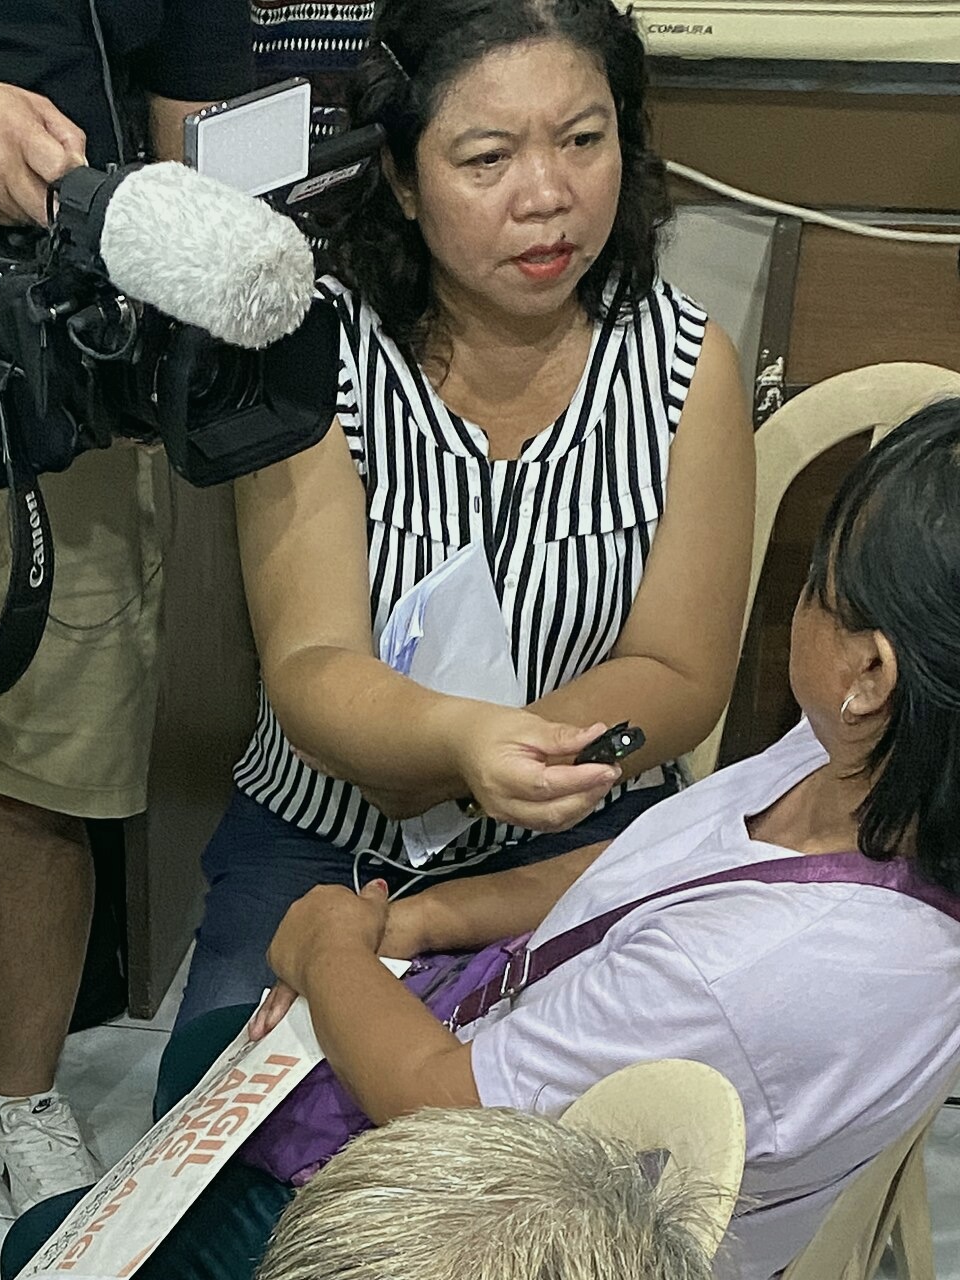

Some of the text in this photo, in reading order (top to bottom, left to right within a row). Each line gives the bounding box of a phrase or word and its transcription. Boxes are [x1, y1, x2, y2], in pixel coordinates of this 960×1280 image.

[25, 490, 45, 589] Canon
[161, 1068, 248, 1161] ANG
[171, 1054, 301, 1178] ITIGIL
